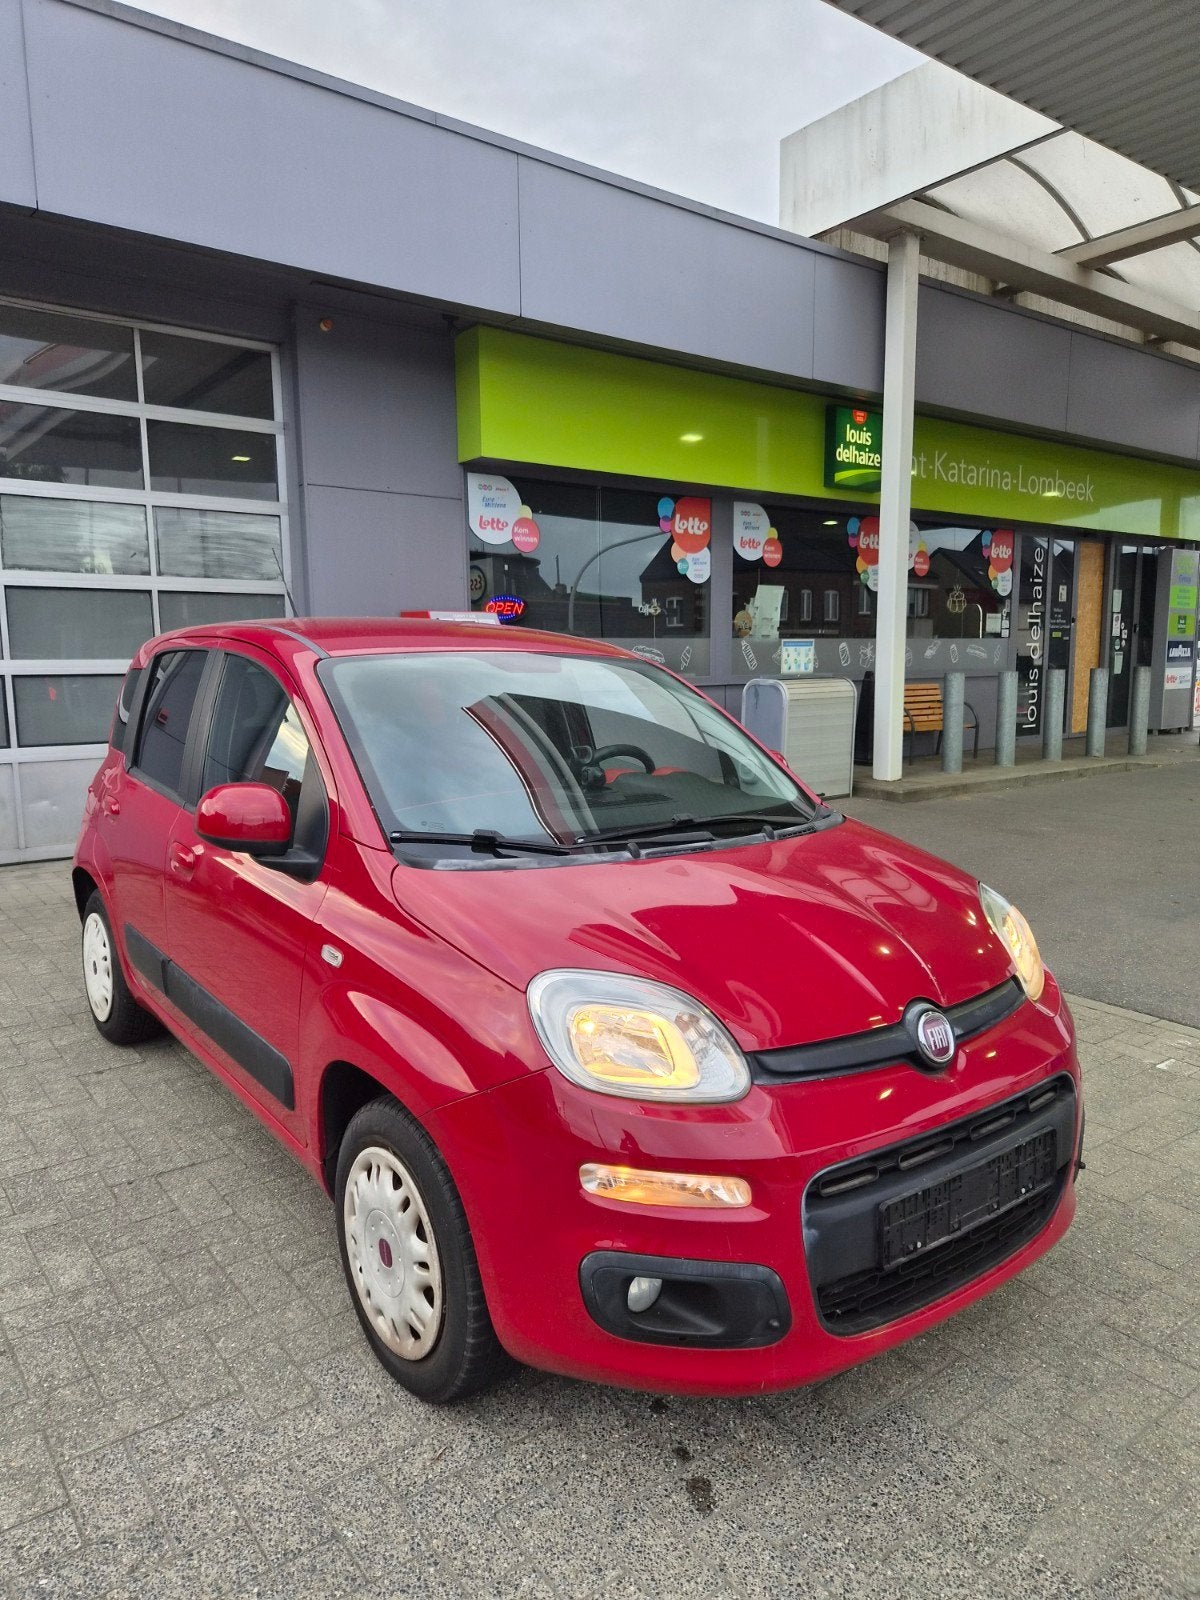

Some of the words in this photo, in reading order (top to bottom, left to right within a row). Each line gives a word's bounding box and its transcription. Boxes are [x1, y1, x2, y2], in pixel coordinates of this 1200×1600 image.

[846, 424, 872, 445] louis
[836, 443, 881, 467] delhaize
[910, 450, 1095, 503] nt-Katarina-Lombeek
[485, 602, 525, 615] OPEN
[1026, 547, 1045, 660] delhaize
[1022, 668, 1039, 729] louis
[926, 1024, 949, 1051] FIAT
